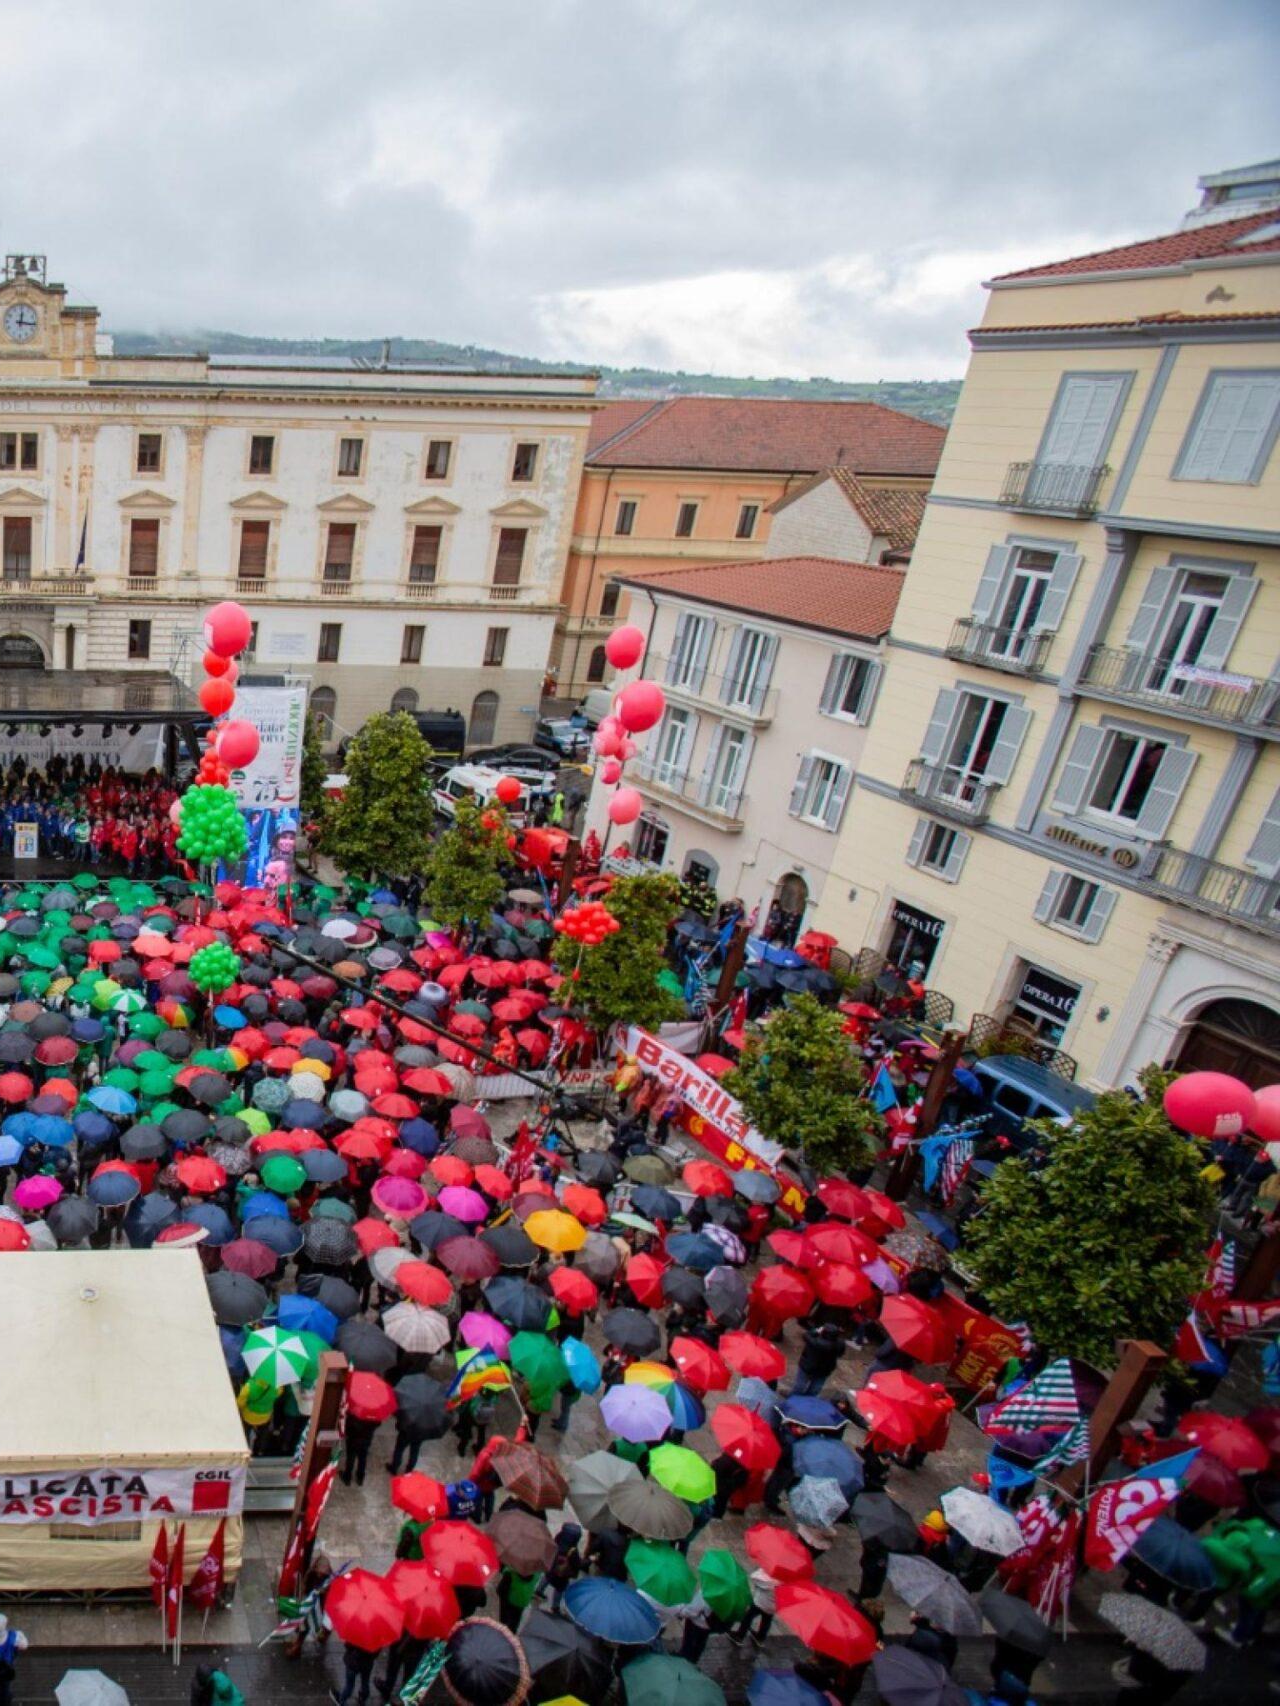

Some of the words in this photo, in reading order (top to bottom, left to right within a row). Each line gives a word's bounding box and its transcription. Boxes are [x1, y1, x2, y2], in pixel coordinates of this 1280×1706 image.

[893, 909, 923, 930] OPERA
[923, 920, 944, 938] 16
[1024, 984, 1054, 1006] OPERA
[1056, 996, 1077, 1012] 16
[635, 1036, 750, 1141] Barilla
[195, 1471, 231, 1480] CGIL
